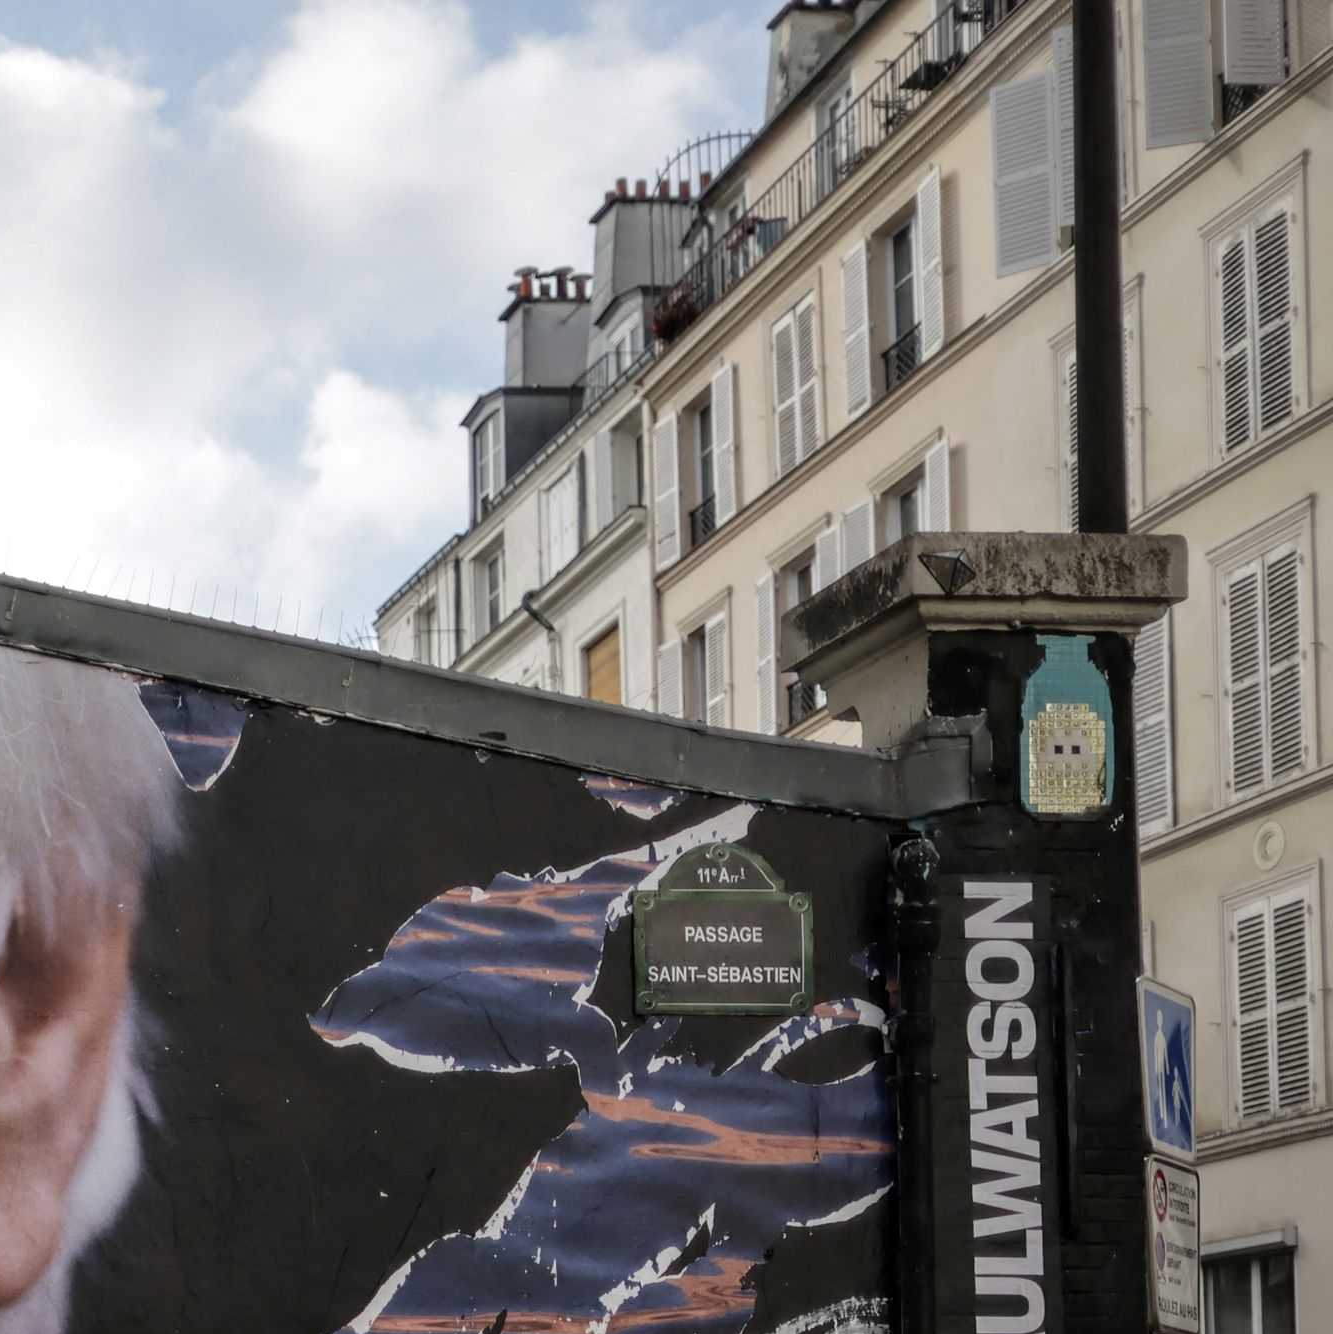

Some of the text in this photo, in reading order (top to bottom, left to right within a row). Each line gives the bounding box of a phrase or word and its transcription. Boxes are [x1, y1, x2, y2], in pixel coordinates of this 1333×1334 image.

[684, 926, 764, 943] PASSAGE
[647, 963, 802, 984] SAINT-SÉBASTIEN
[1168, 1181, 1196, 1199] CIRCULATION
[1168, 1199, 1191, 1215] INTERDITE
[1158, 1297, 1198, 1321] ROULEZ AU PAS
